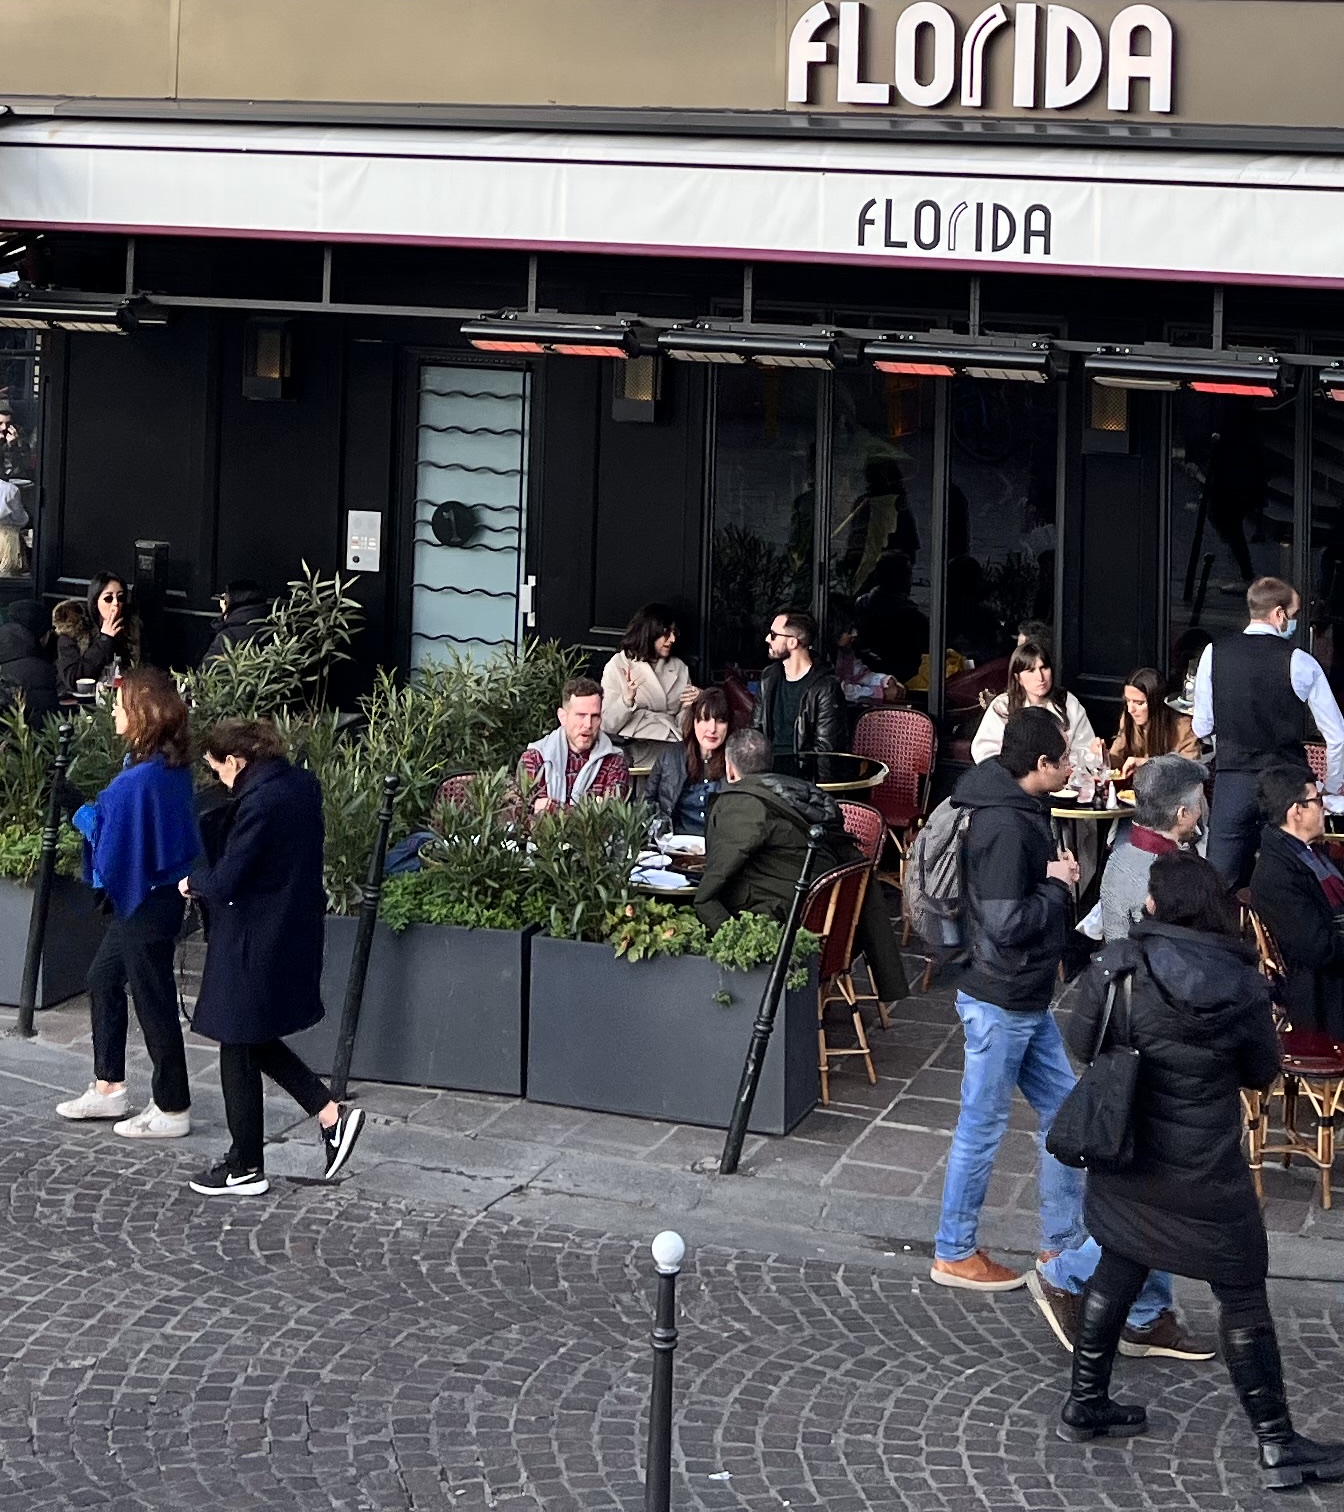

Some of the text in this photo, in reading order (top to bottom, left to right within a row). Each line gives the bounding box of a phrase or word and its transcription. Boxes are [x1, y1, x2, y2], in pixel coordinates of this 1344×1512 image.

[787, 0, 1174, 113] FLORIDA
[857, 197, 1052, 256] FLORIDA
[442, 509, 462, 542] 1
